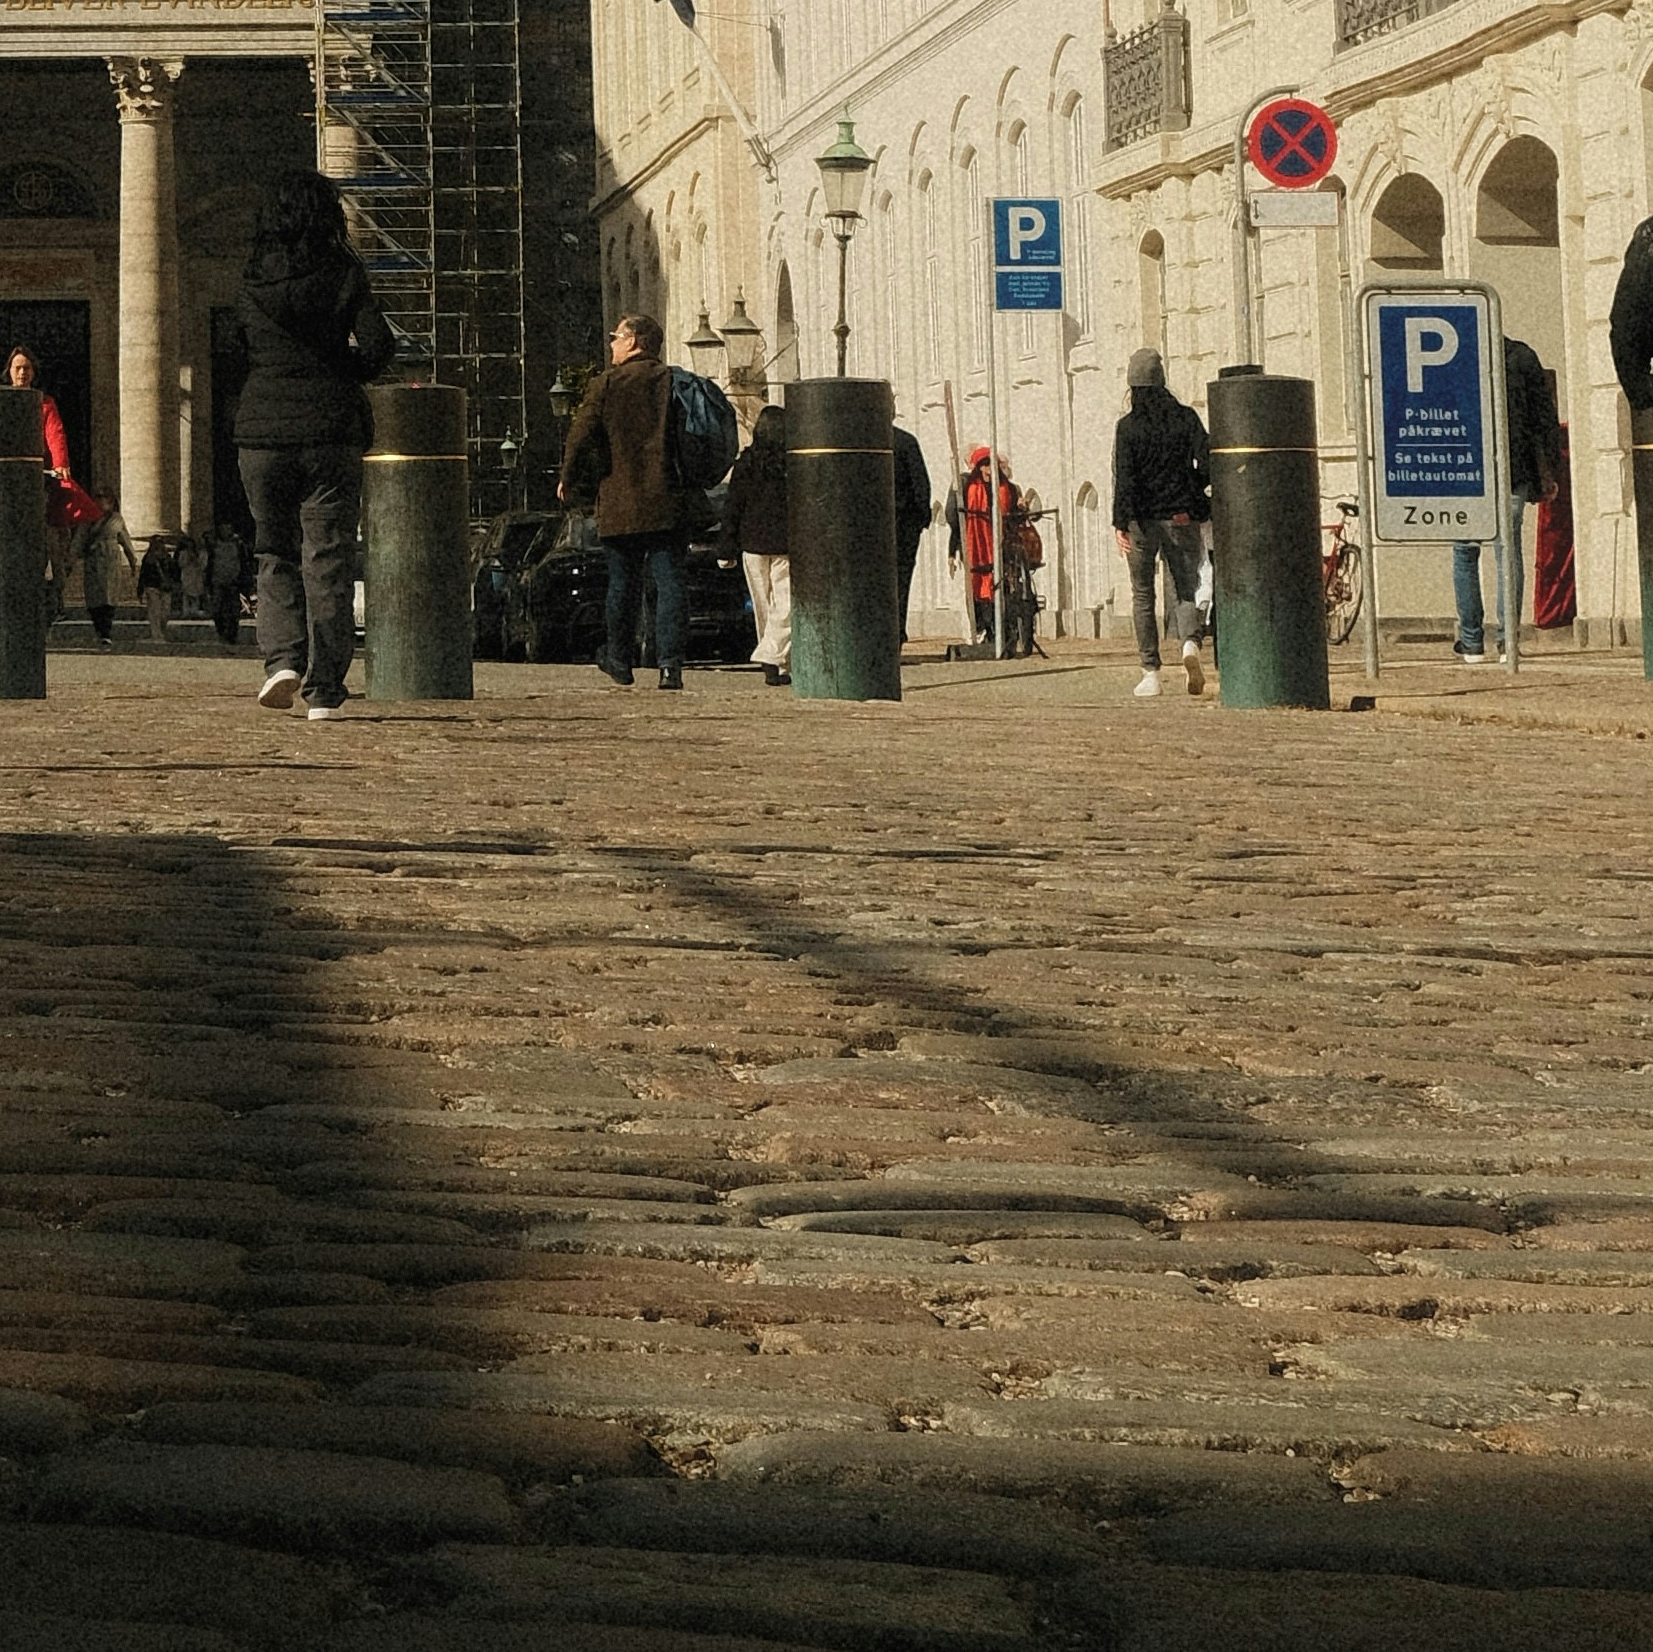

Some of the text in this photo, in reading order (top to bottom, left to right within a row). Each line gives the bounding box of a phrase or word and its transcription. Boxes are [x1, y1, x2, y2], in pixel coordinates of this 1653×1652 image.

[1008, 206, 1046, 260] P
[1404, 316, 1459, 393] P
[1398, 425, 1467, 440] påkrævet
[1394, 452, 1474, 467] Se tekst på
[1387, 470, 1482, 482] billetautomat
[1403, 506, 1468, 525] Zone
